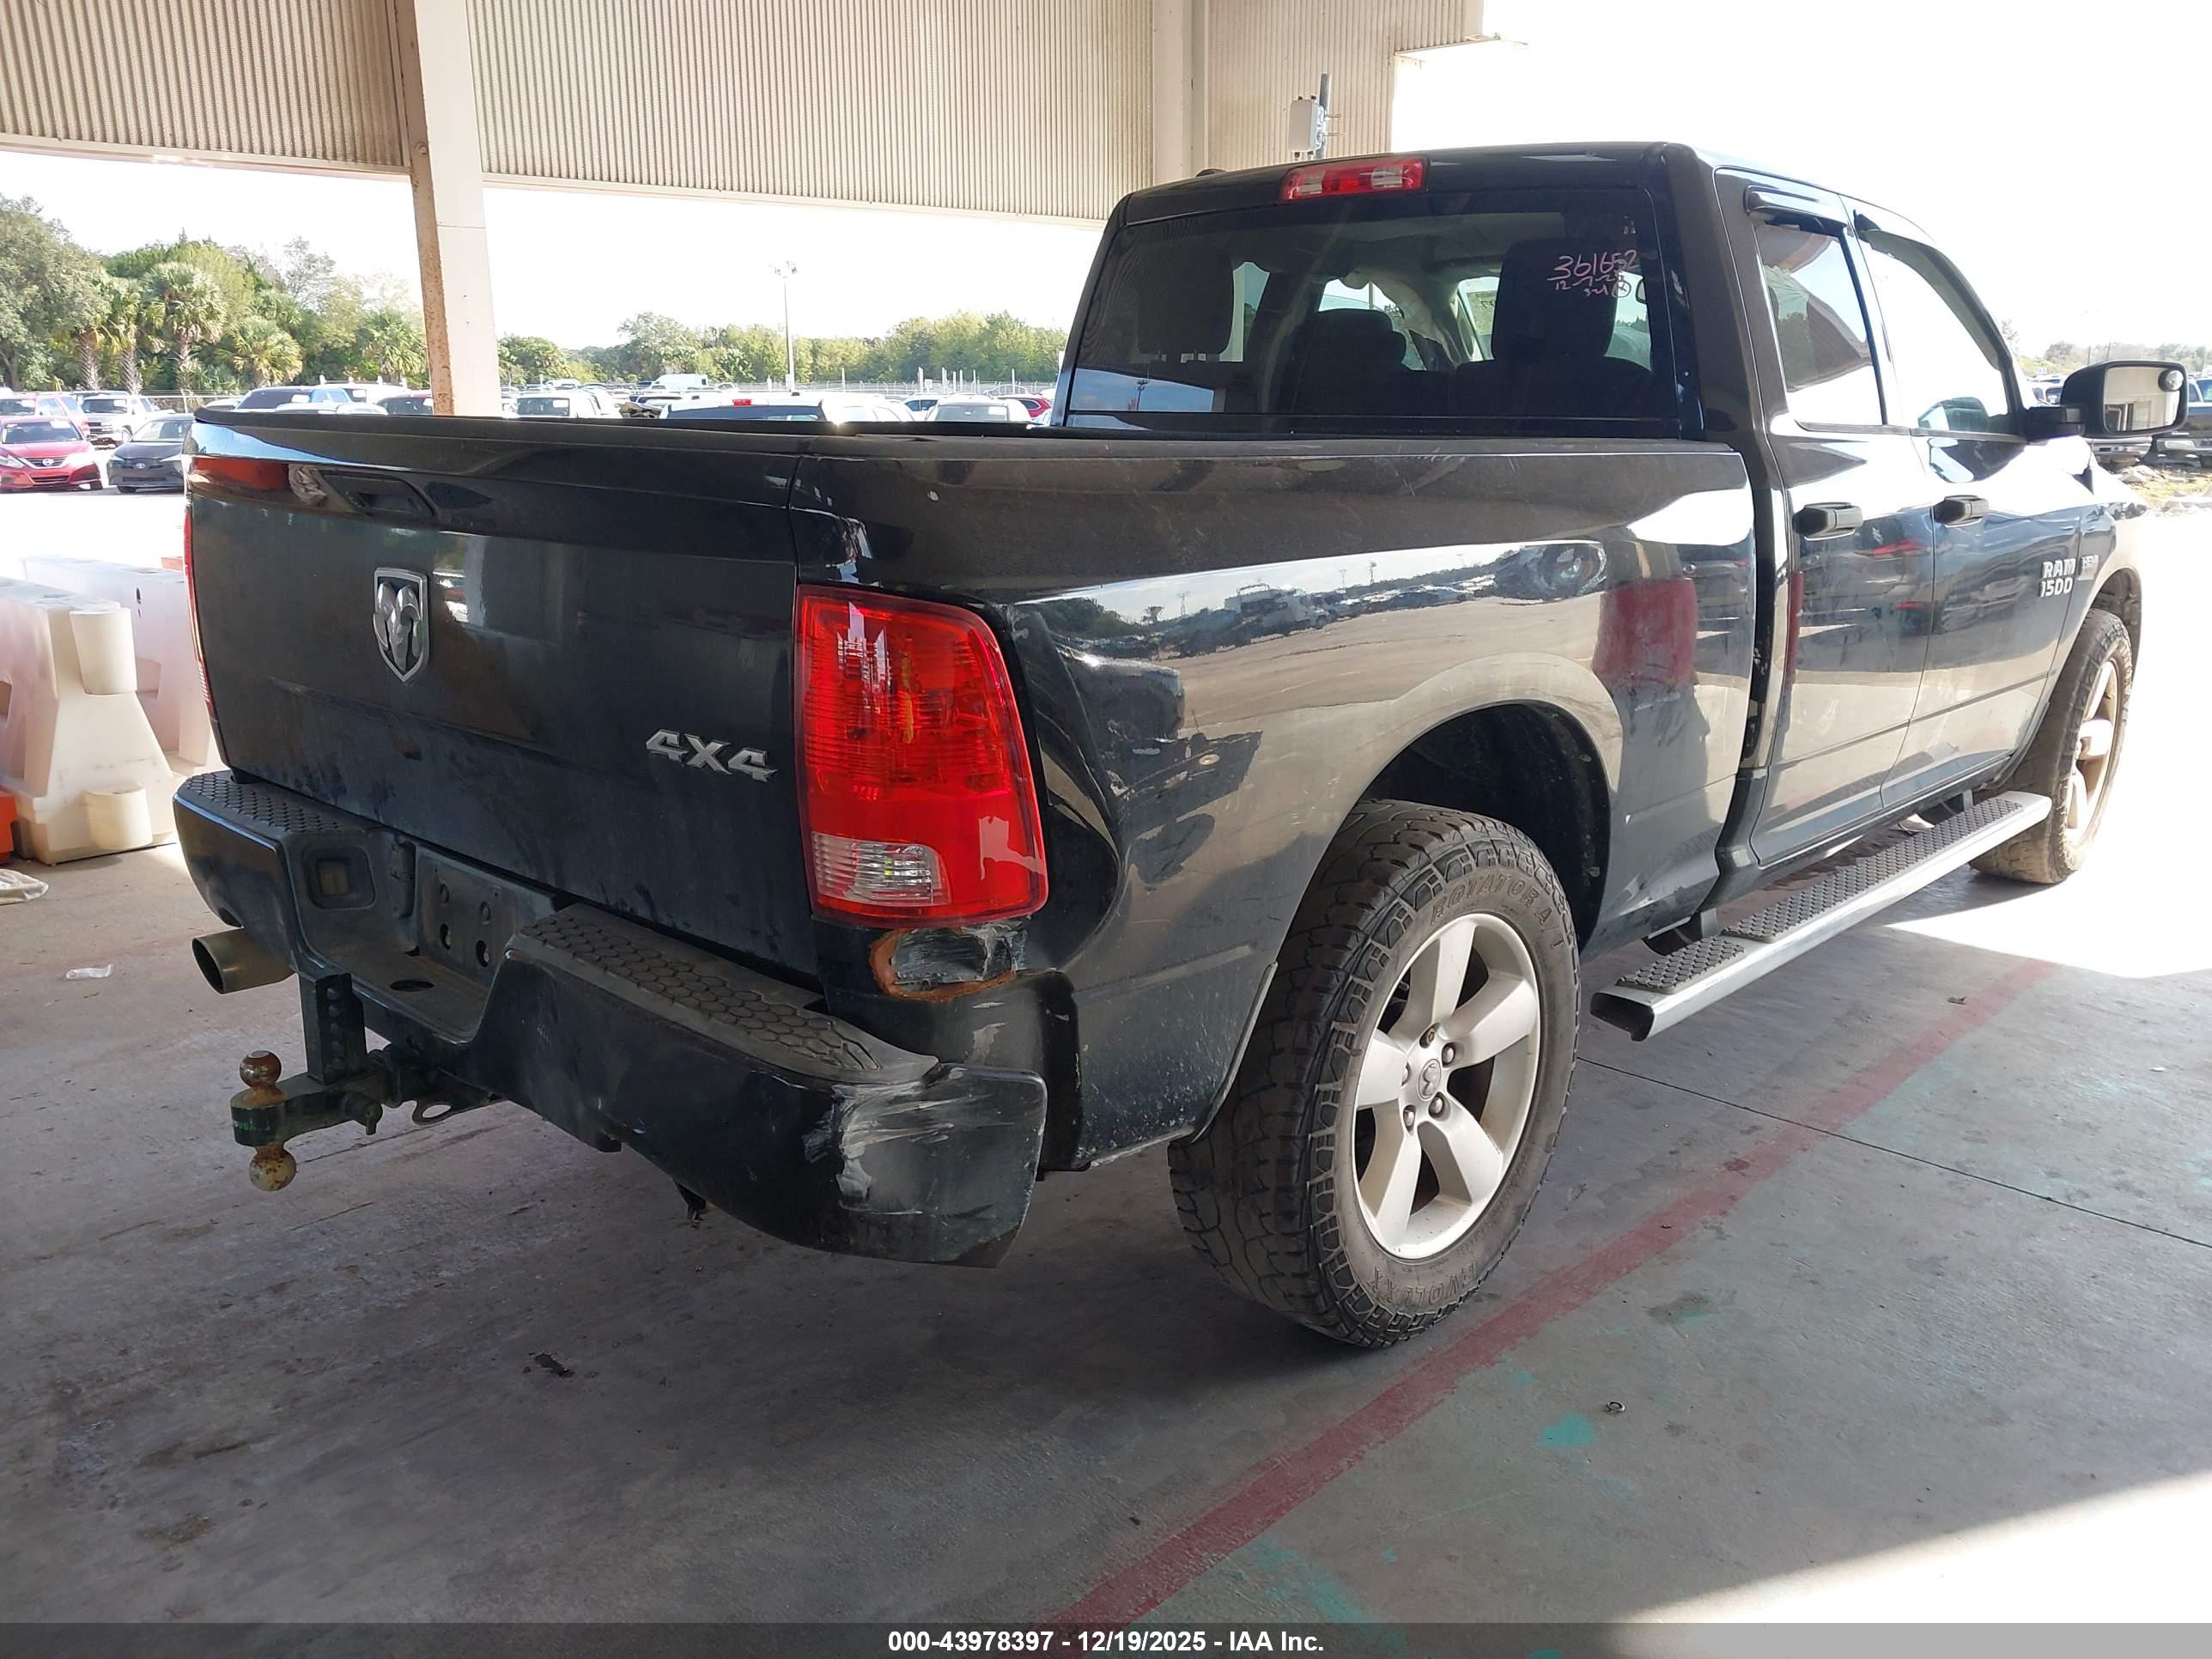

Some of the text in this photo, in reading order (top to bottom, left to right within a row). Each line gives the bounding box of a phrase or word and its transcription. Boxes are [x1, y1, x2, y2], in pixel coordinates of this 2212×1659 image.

[1547, 249, 1640, 281] 361652
[2041, 557, 2076, 579] RAM
[2039, 577, 2073, 598] 1500
[1430, 870, 1540, 926] ROTATOR
